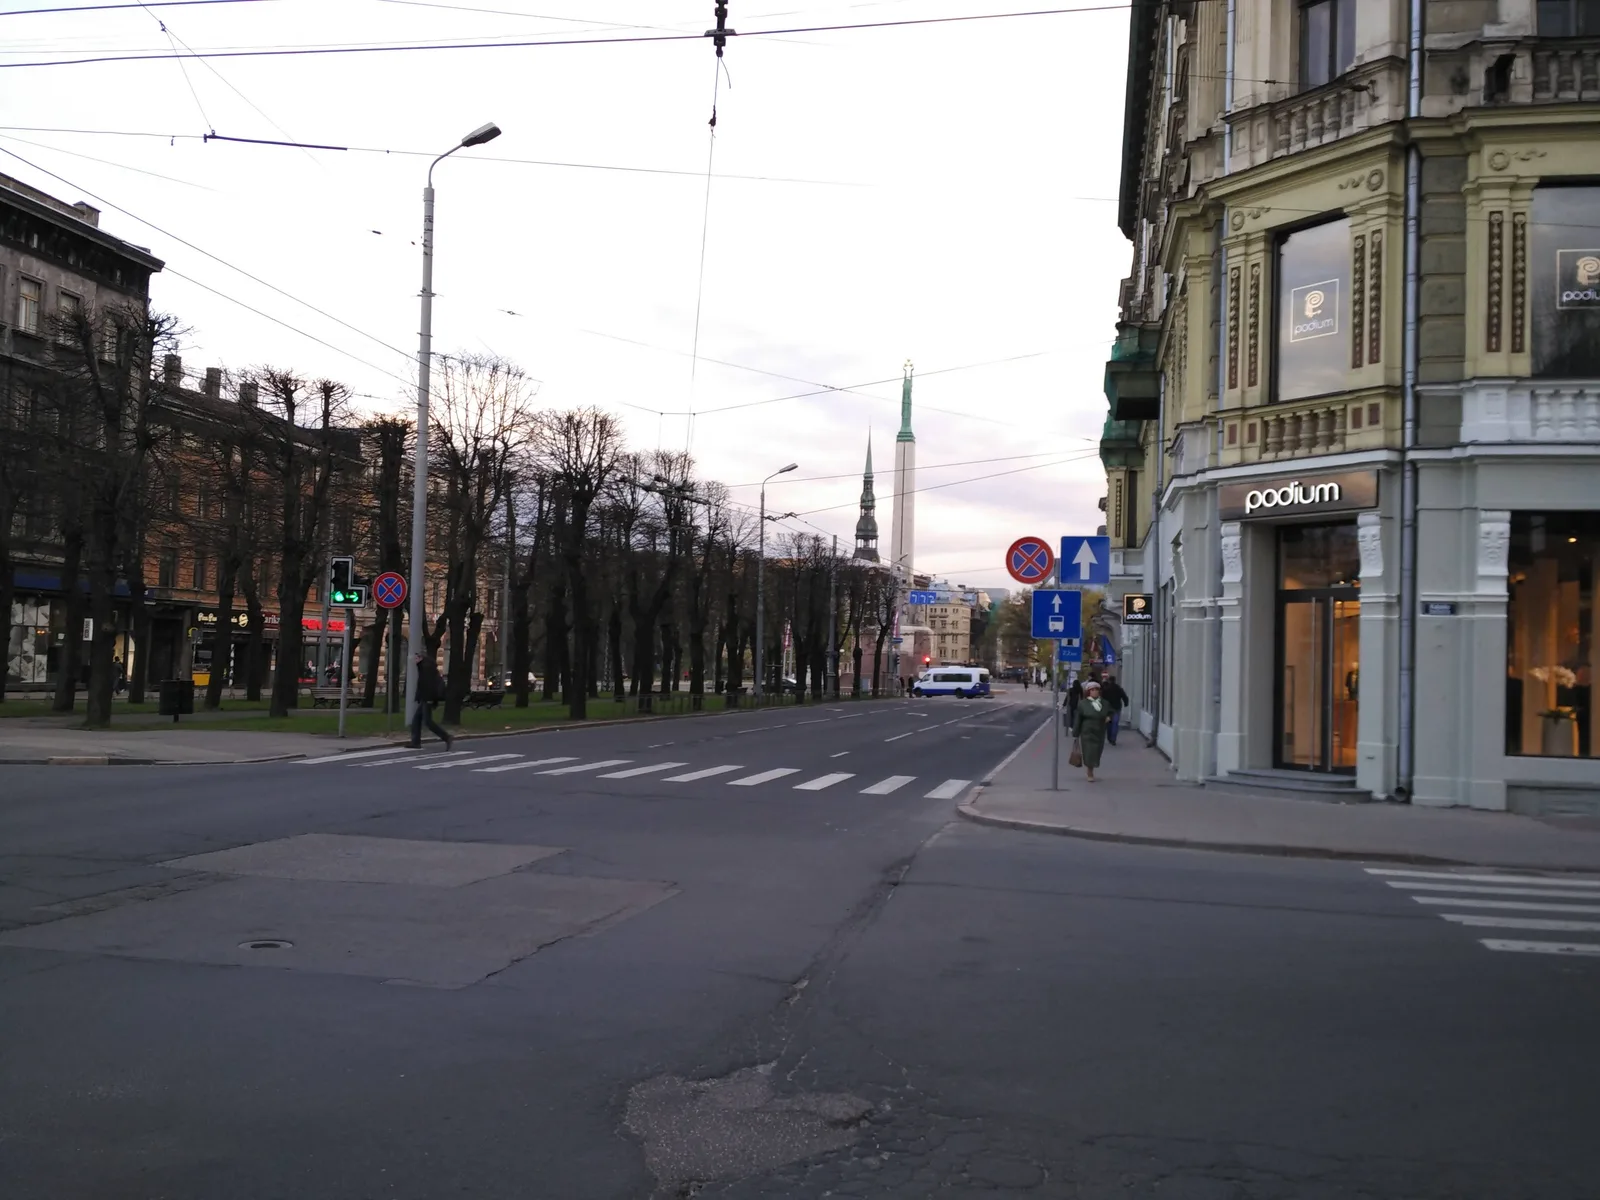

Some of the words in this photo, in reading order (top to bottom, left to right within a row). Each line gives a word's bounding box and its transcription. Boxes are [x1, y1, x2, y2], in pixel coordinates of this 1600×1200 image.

[1562, 288, 1600, 302] podiu
[1294, 318, 1333, 335] podium
[1245, 481, 1339, 514] podium
[1126, 612, 1152, 620] podium
